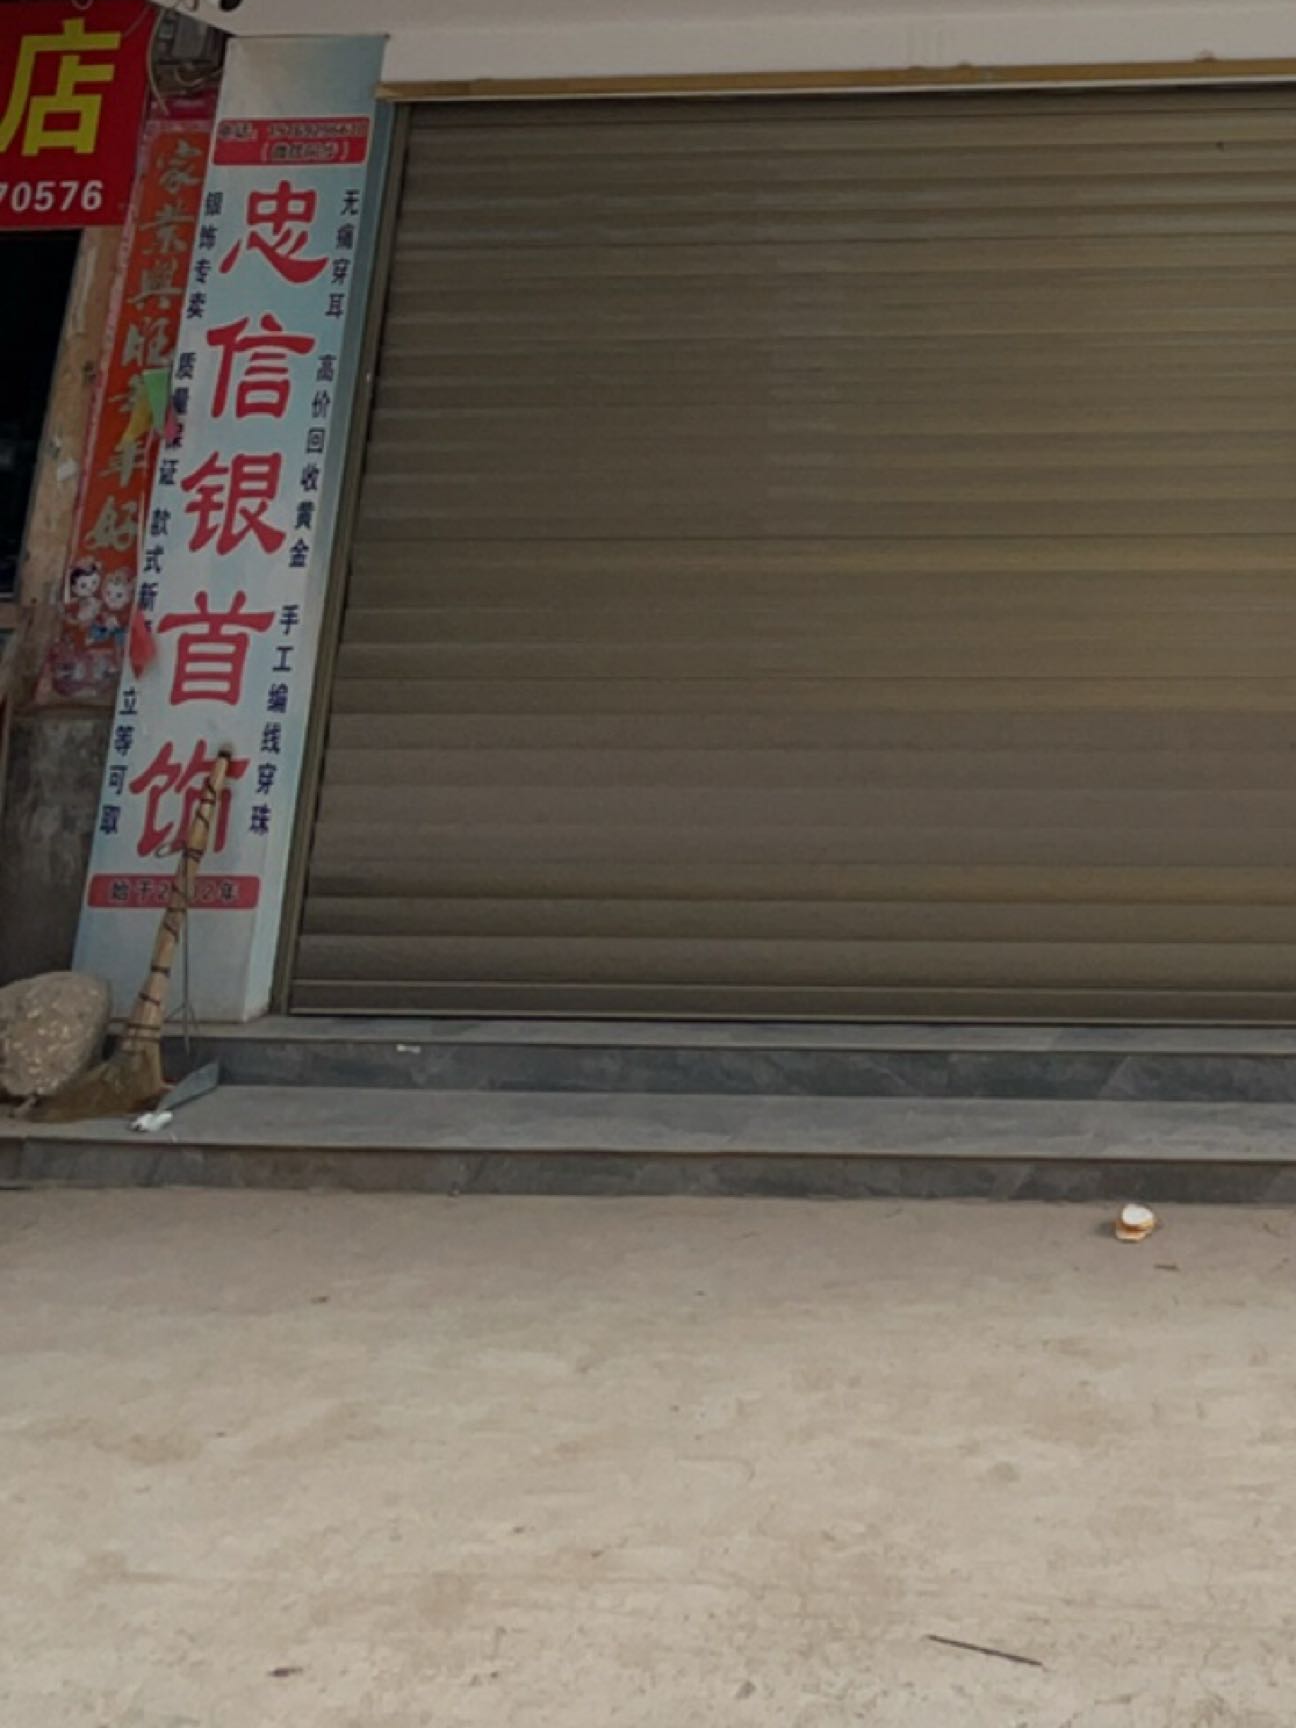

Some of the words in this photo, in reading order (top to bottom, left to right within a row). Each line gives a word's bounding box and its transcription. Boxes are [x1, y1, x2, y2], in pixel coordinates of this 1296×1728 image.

[0, 17, 121, 157] 店
[128, 178, 331, 858] 忠信银首饰
